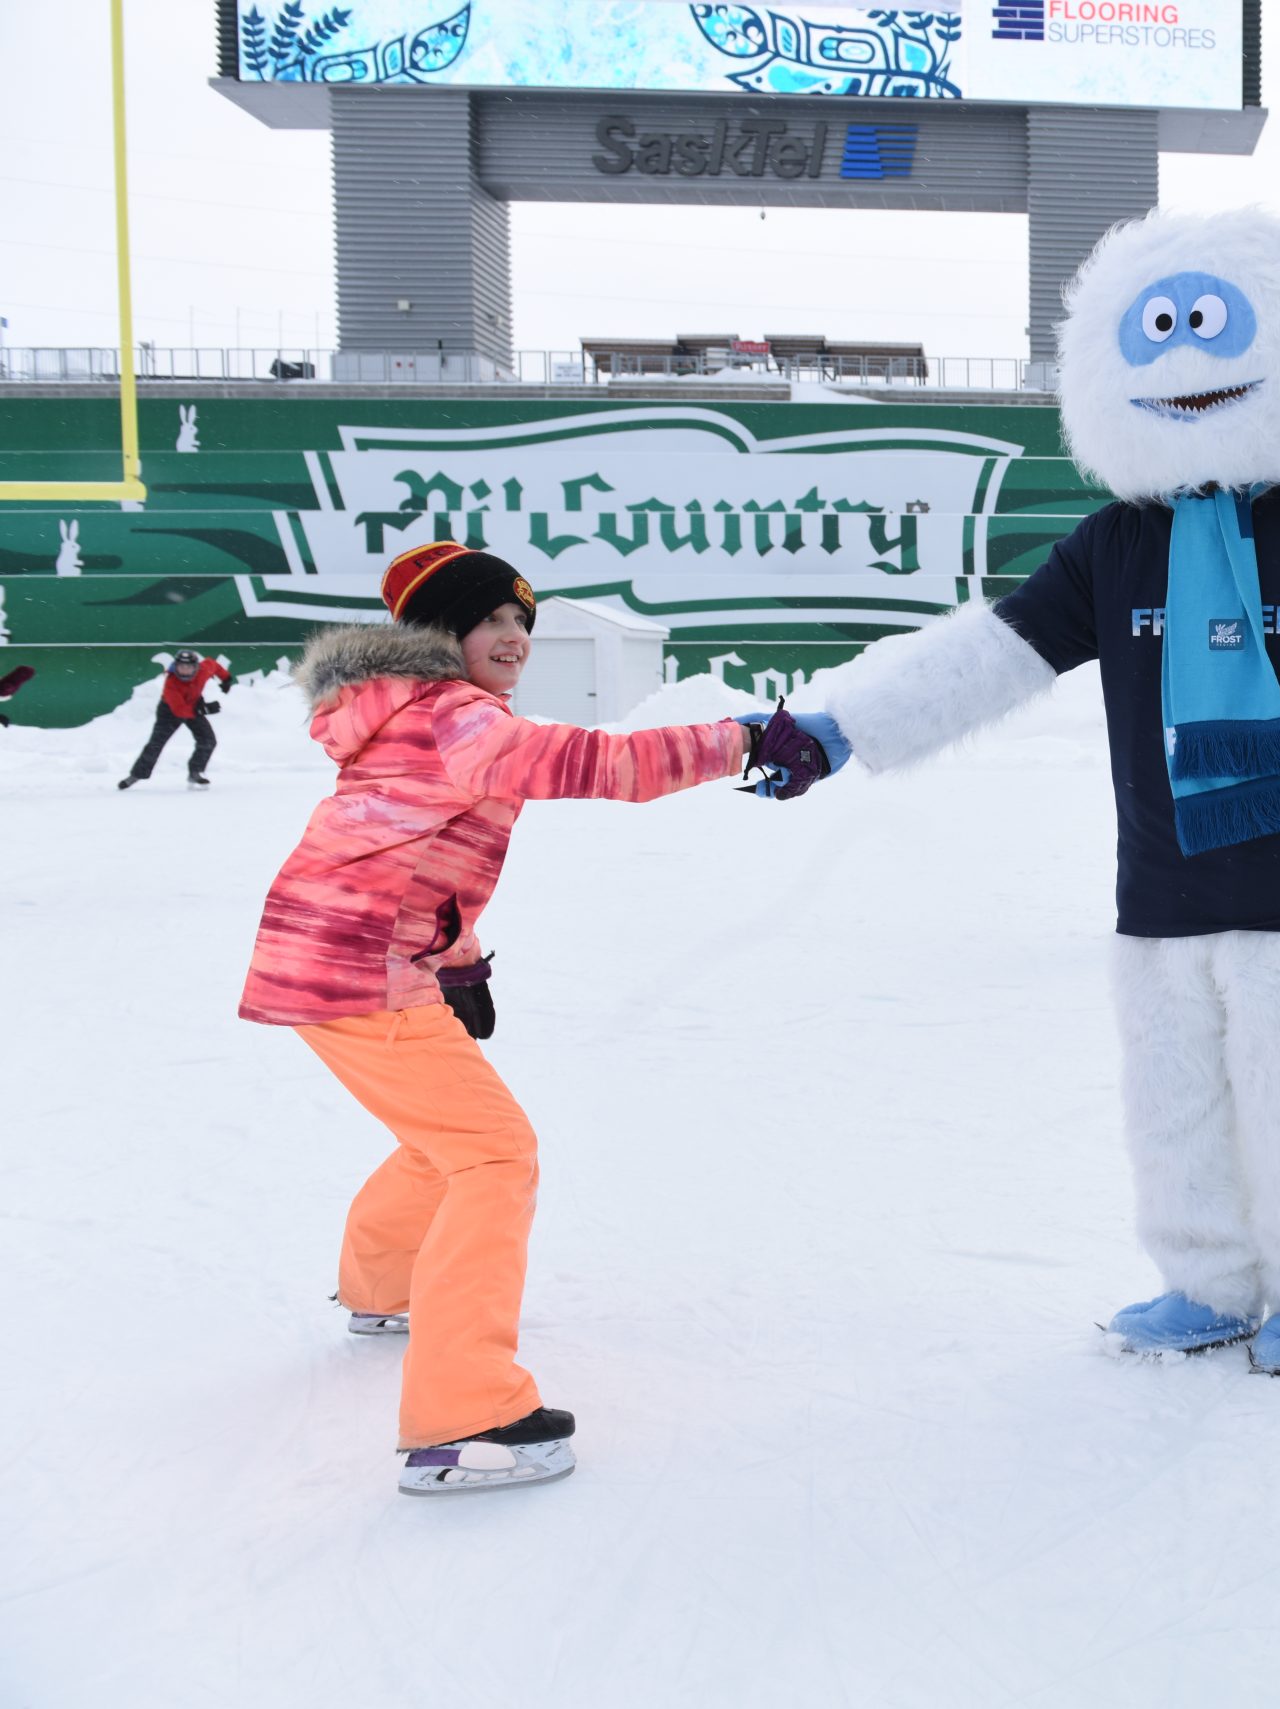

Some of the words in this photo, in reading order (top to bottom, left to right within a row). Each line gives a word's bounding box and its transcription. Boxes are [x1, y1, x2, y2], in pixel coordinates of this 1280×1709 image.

[1049, 0, 1179, 24] FLOORING
[1048, 22, 1216, 49] SUPERSTORES
[591, 115, 828, 178] SaskTel
[529, 472, 921, 575] Country
[1211, 635, 1242, 643] FROST
